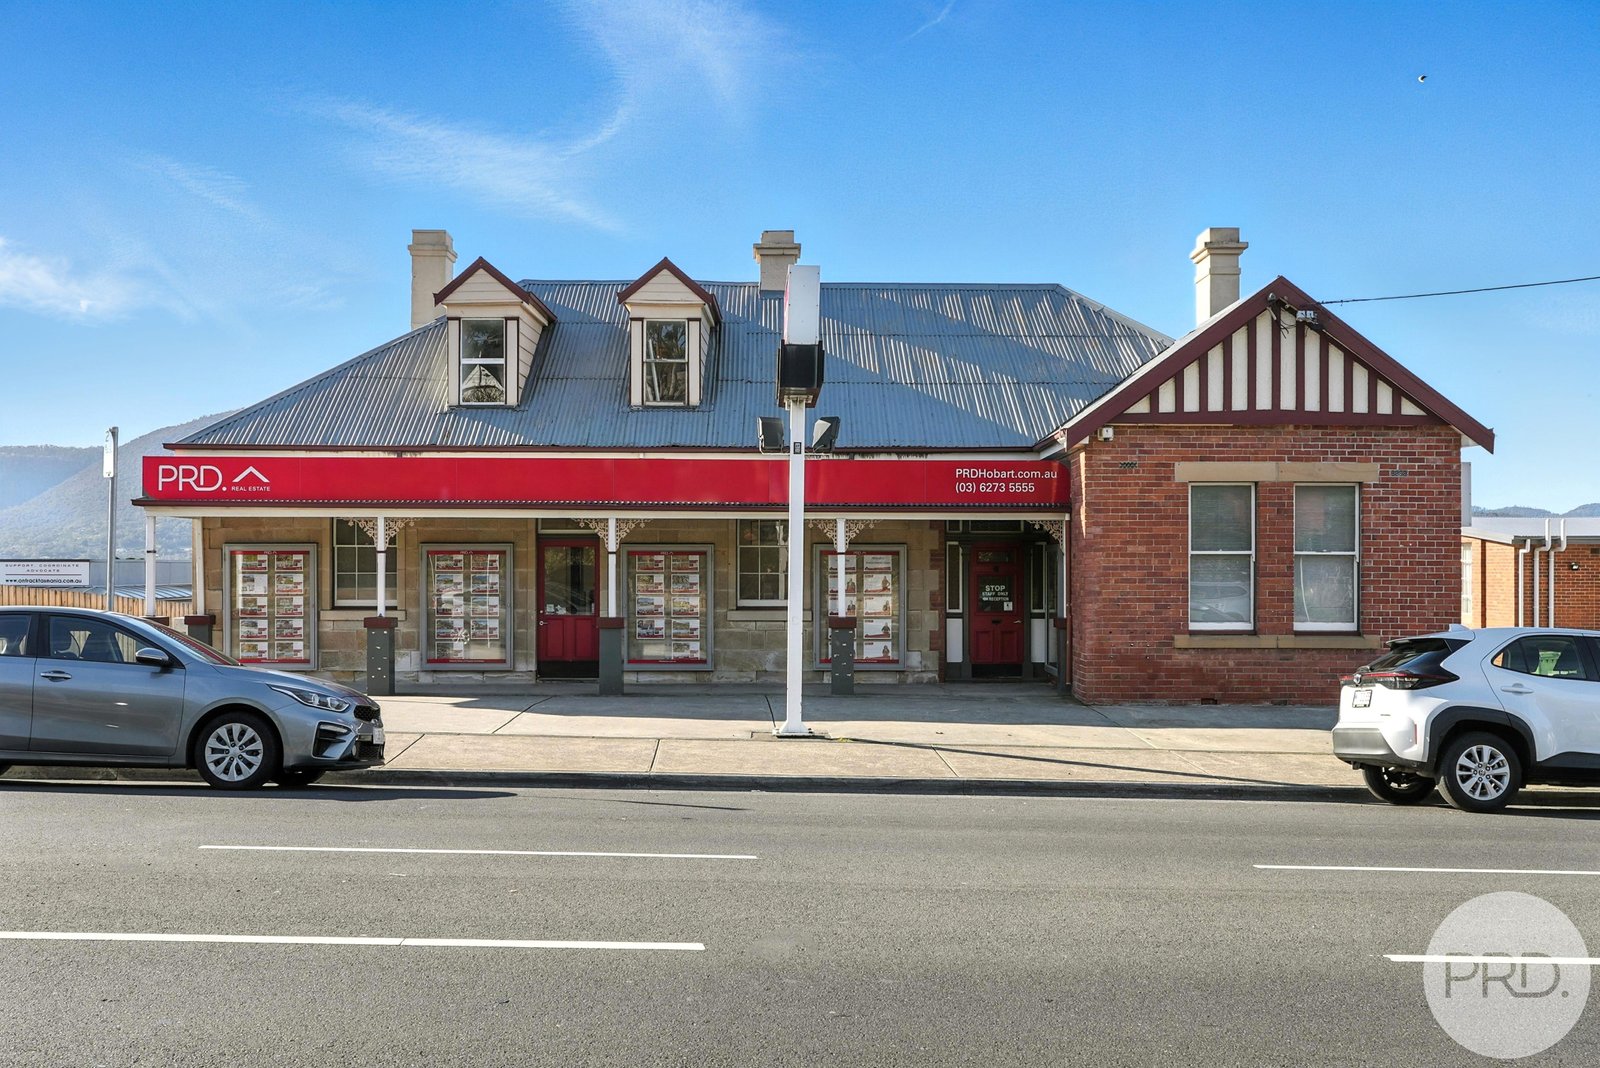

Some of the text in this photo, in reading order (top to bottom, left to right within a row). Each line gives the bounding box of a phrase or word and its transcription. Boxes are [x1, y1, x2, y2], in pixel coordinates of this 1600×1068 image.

[955, 468, 1057, 479] PRDHobart.com.au
[955, 482, 1035, 494] (03) 6273 5555
